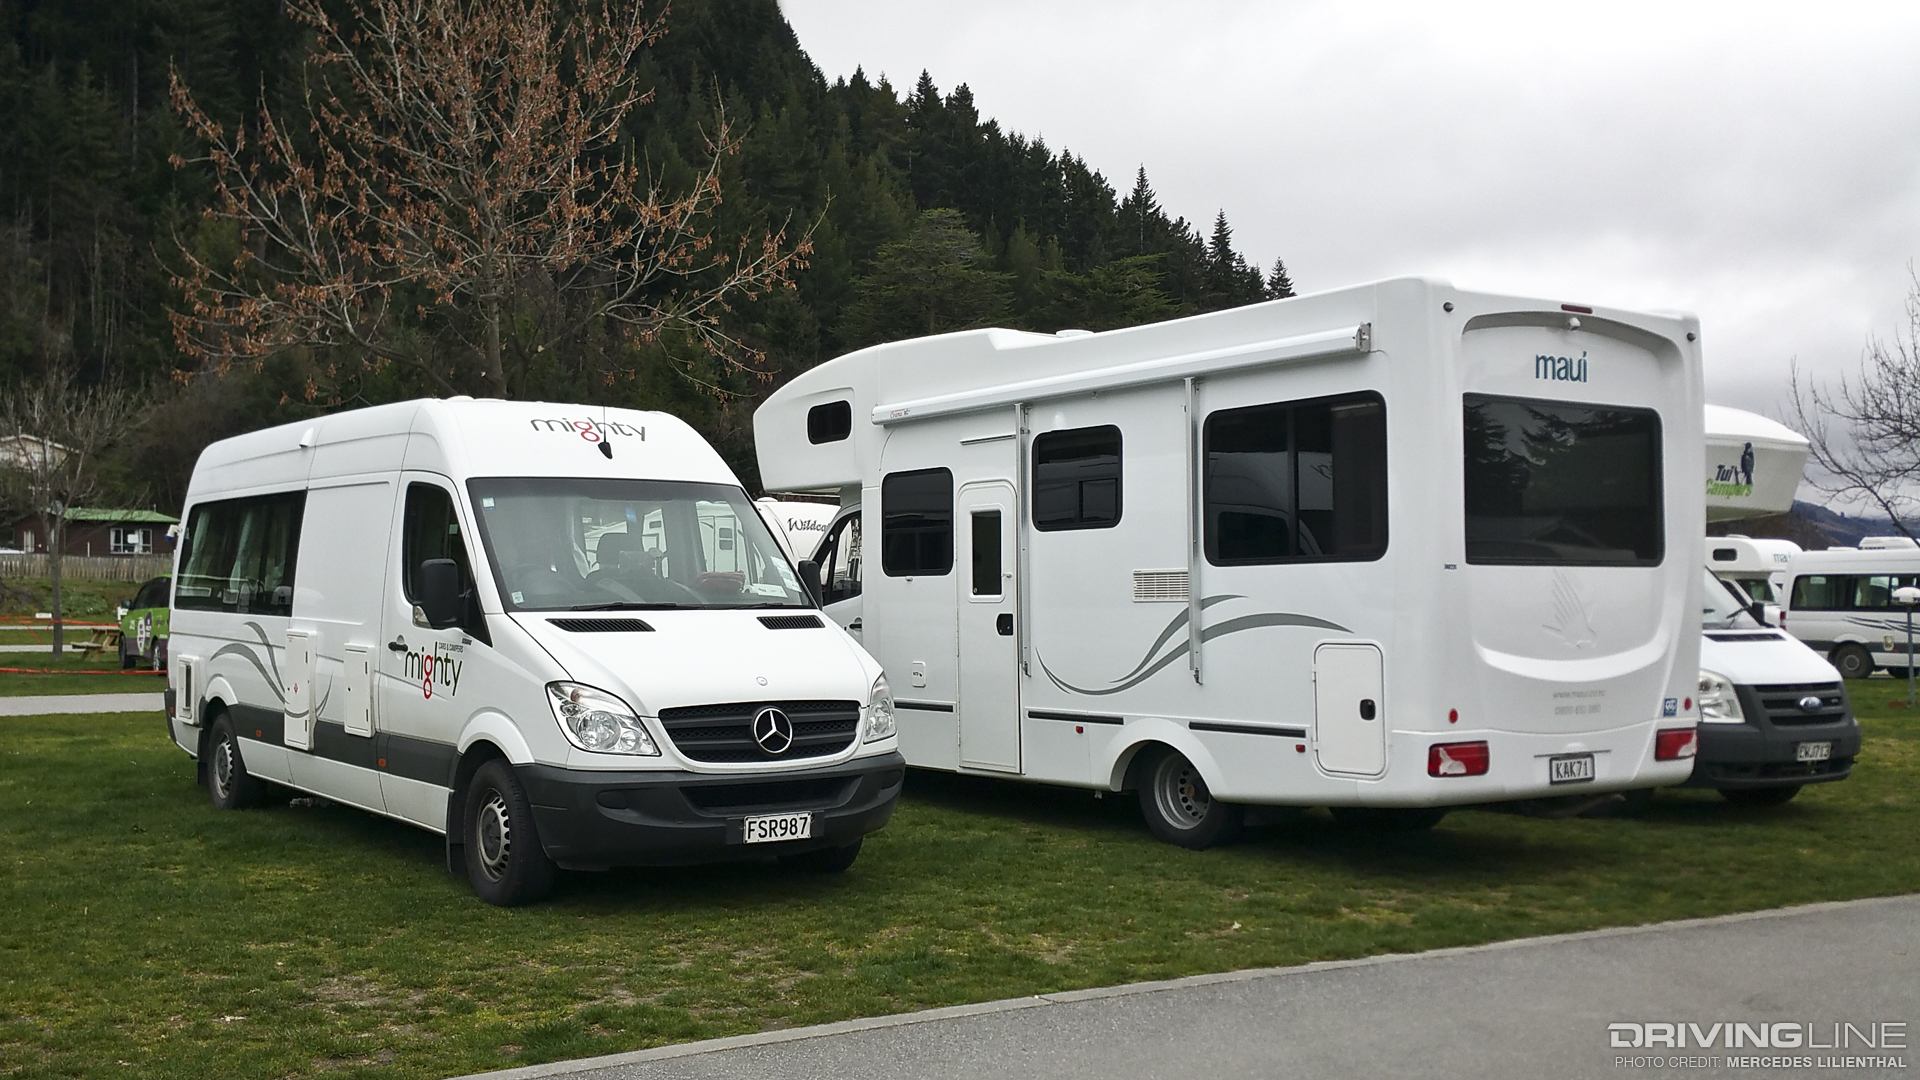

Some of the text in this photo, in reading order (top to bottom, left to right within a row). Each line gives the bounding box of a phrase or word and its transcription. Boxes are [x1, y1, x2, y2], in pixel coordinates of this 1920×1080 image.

[1535, 350, 1587, 383] maui
[530, 416, 646, 442] mighty
[1715, 464, 1735, 482] Tui
[404, 641, 463, 699] mighty
[1556, 760, 1588, 779] KAK71
[747, 817, 808, 839] FSR987
